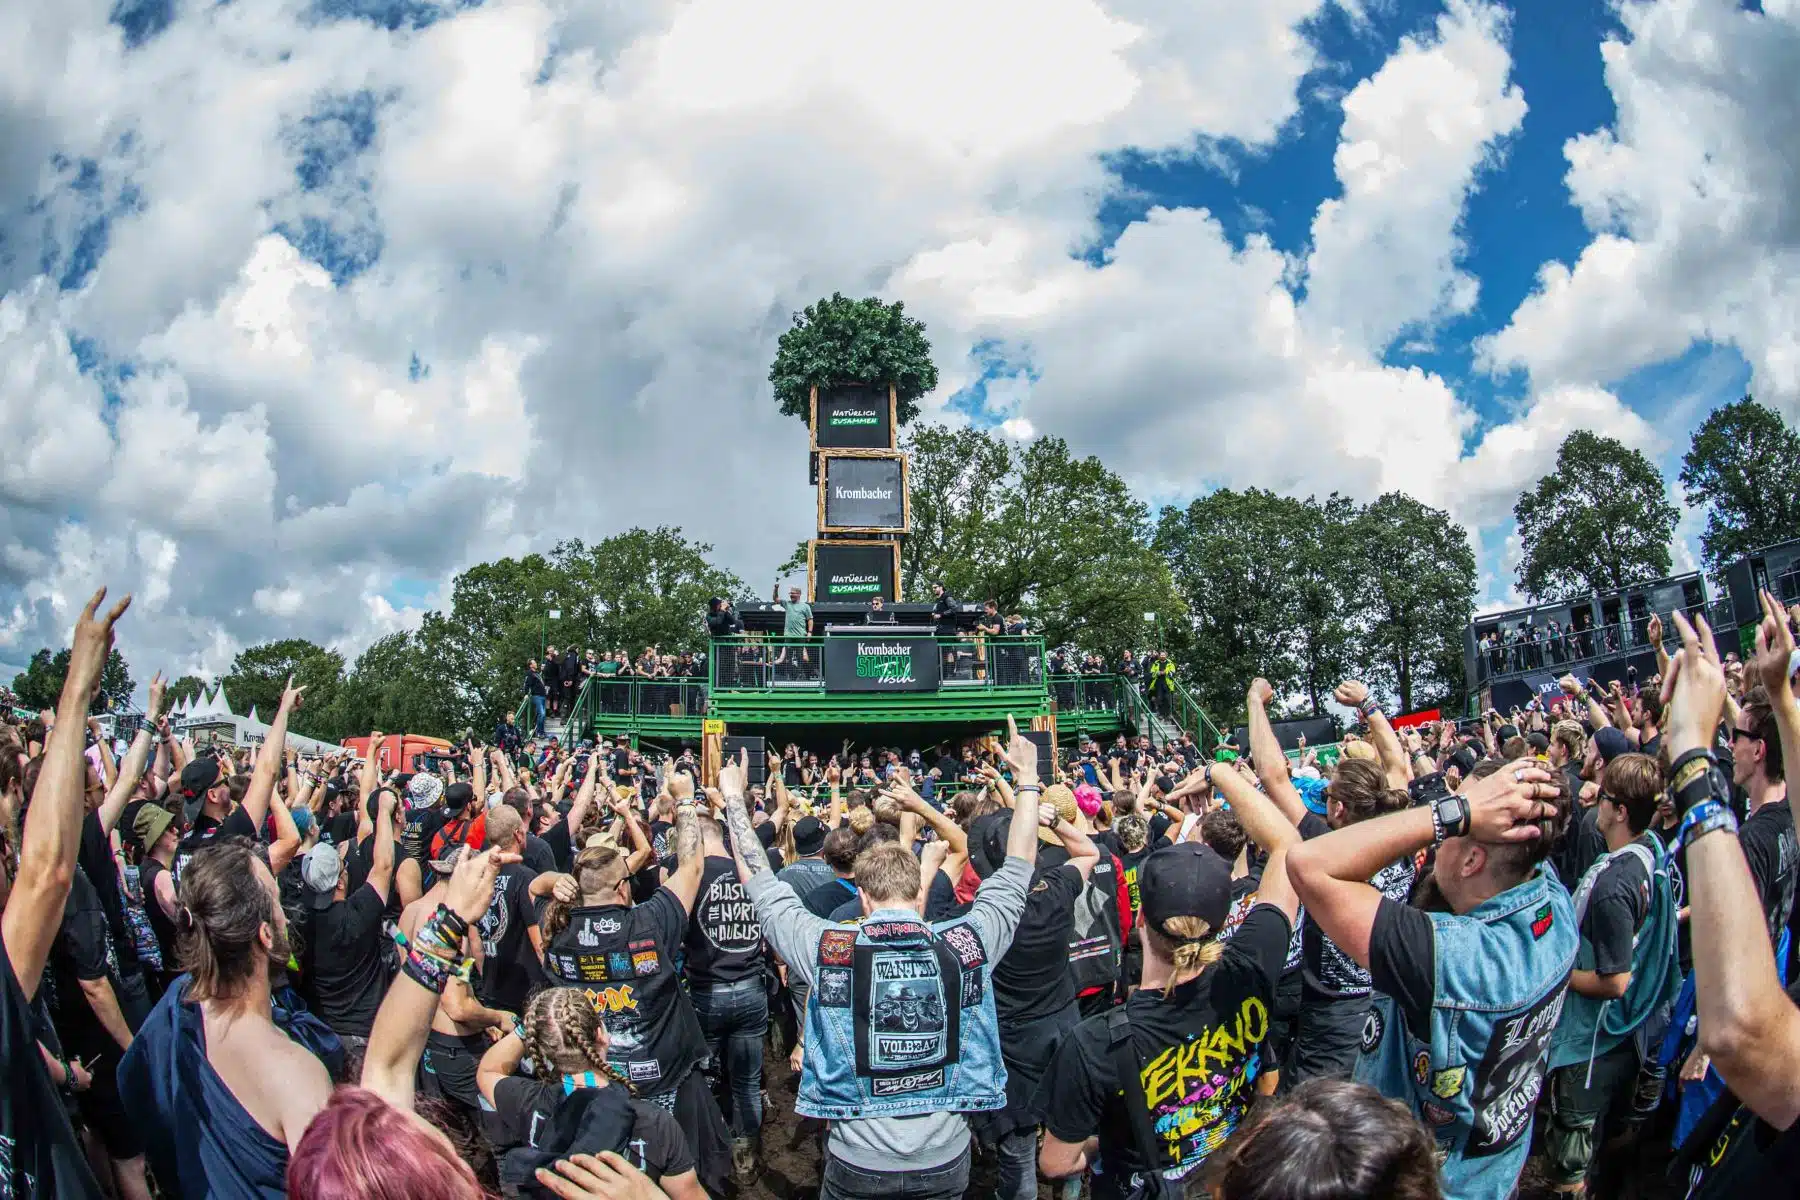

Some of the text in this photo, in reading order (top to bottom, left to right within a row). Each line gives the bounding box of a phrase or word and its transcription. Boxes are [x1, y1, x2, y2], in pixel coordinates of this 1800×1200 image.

[832, 408, 876, 417] NATÜRLICH
[832, 417, 877, 425] ZUSAMMEN
[835, 486, 893, 499] Krombacher
[831, 573, 879, 583] NATÜRLICH
[831, 584, 880, 593] ZUSAMMEN
[857, 642, 912, 656] Krombacher
[874, 661, 916, 684] Tisch
[875, 959, 938, 980] WANTED
[880, 1038, 938, 1054] VOLBEAT
